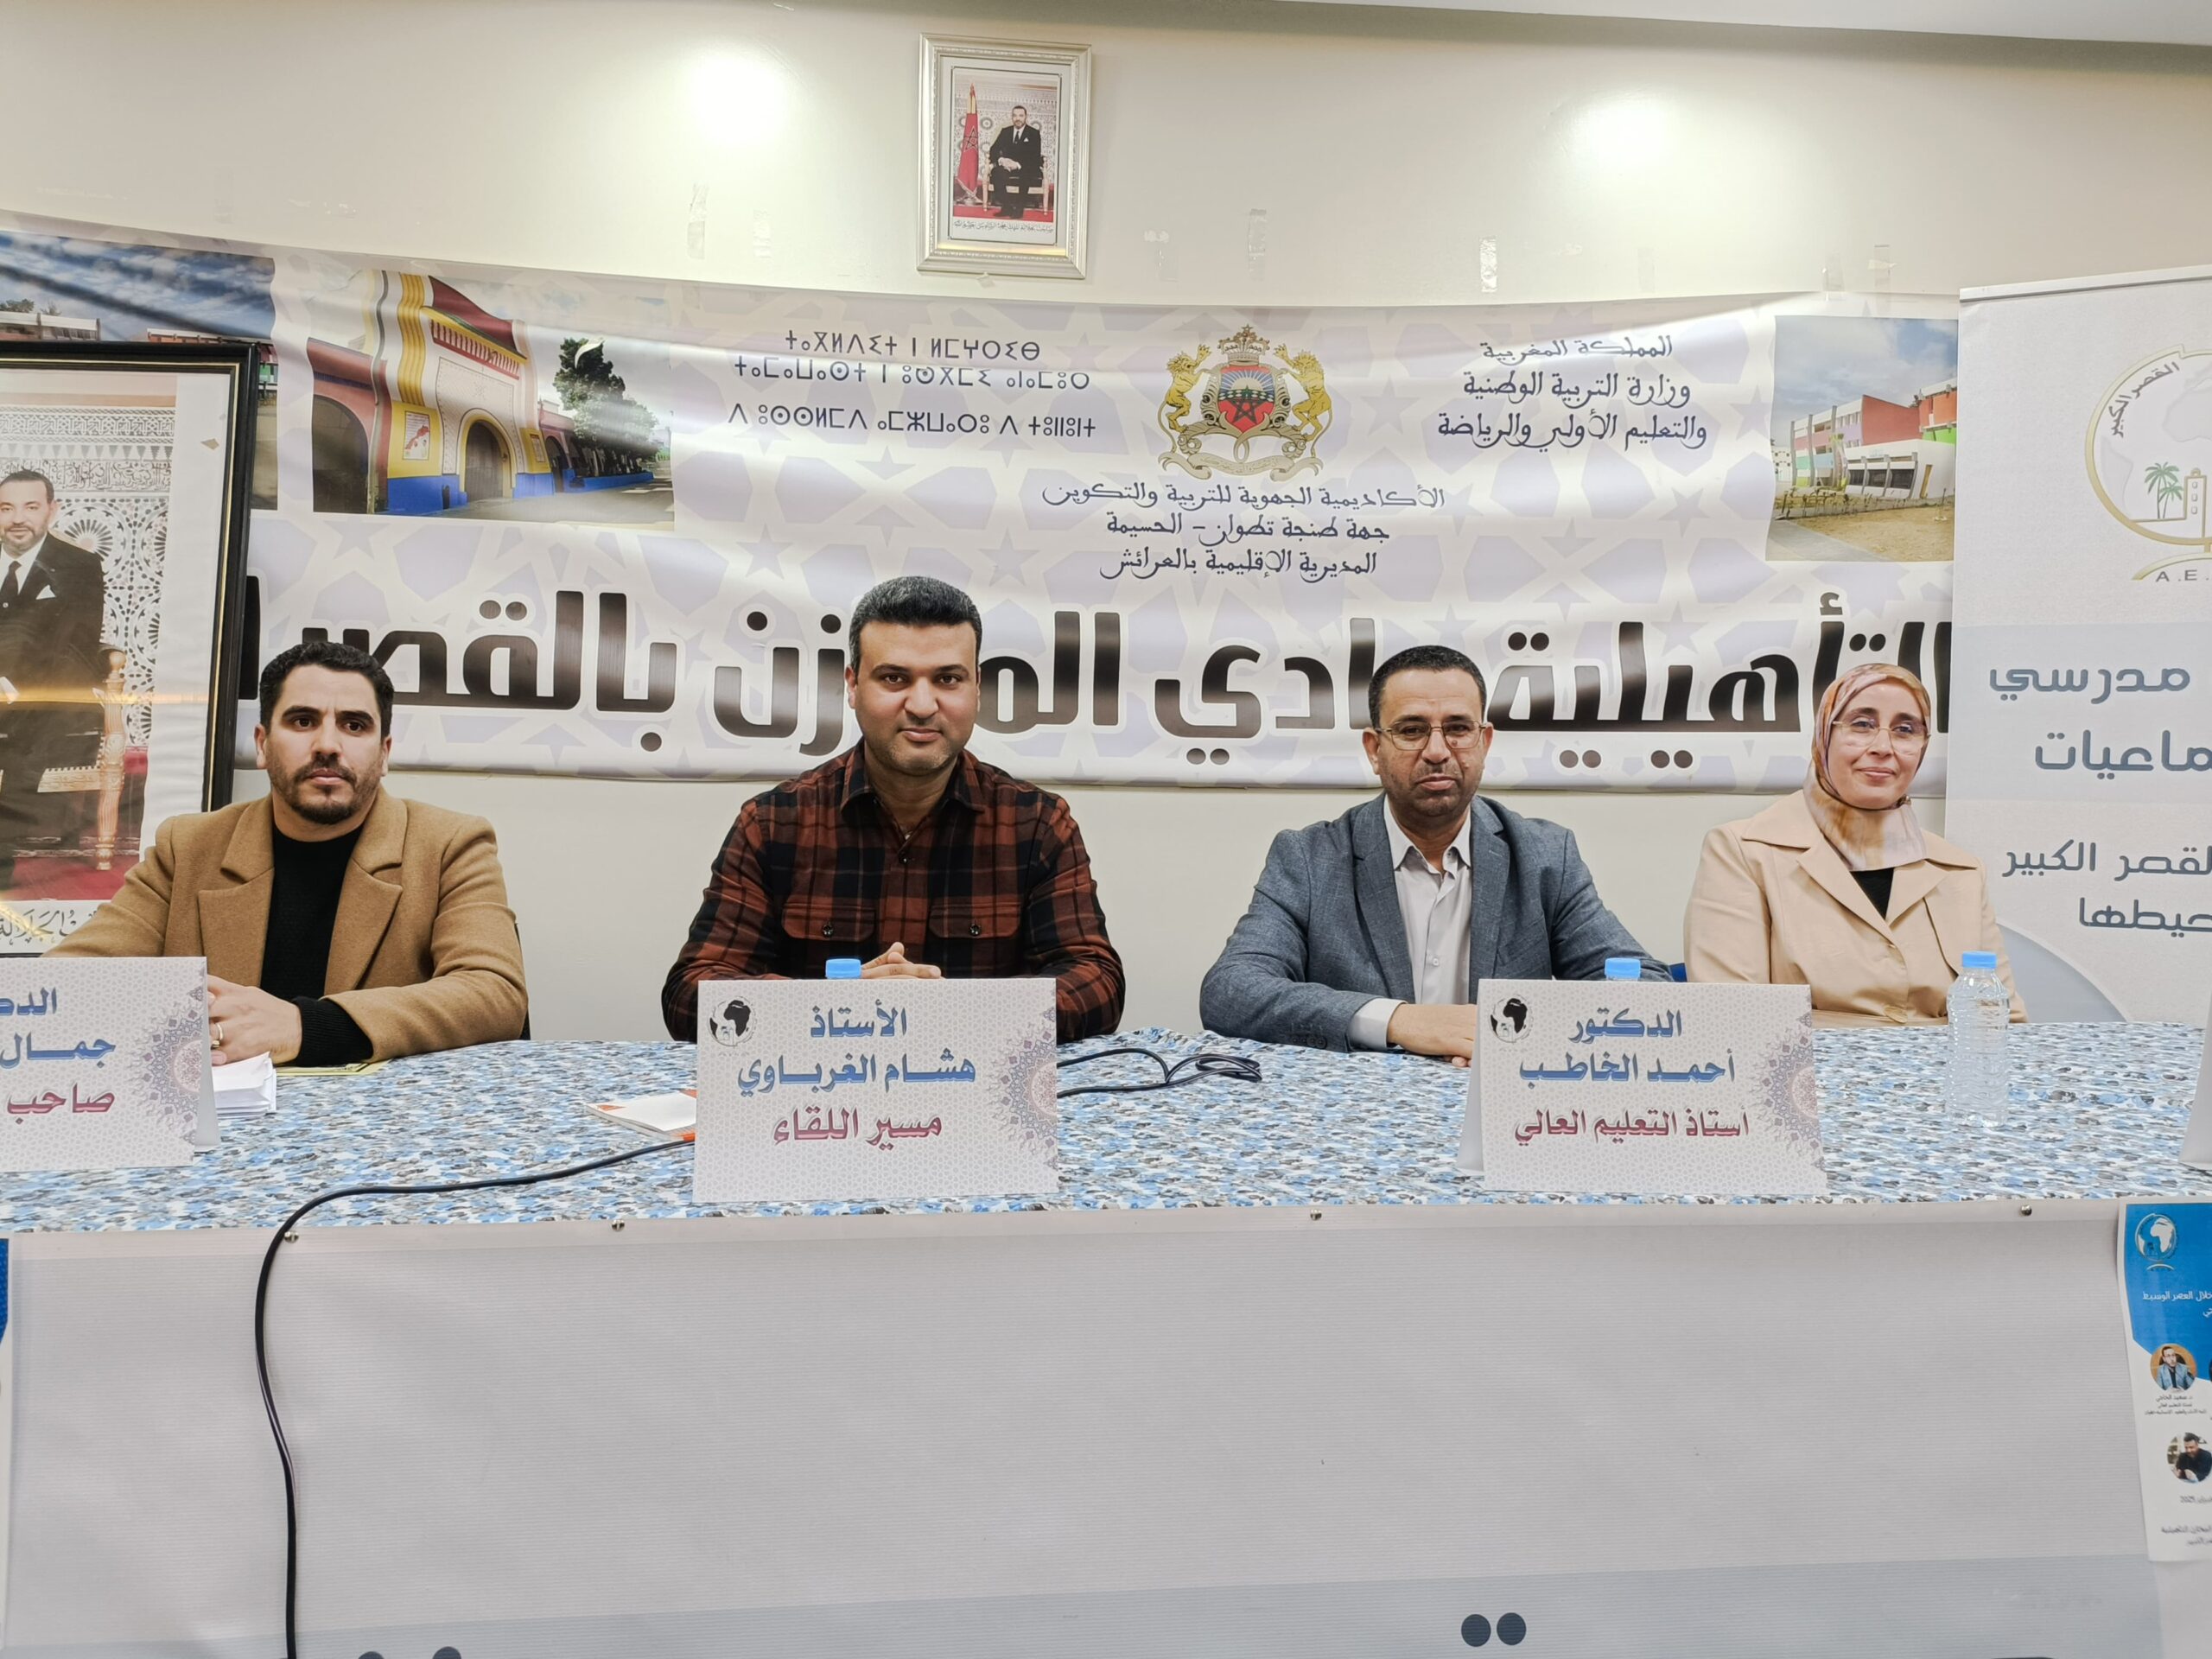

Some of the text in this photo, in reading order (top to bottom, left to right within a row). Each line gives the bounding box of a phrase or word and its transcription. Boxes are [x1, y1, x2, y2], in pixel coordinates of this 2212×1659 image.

[1480, 334, 1673, 366] المملكة المغربية
[1464, 371, 1691, 410] وزارة التربية الوطنية
[2108, 361, 2180, 439] القصر الكبير
[1438, 408, 1707, 453] والتعليم الأولي والرياضة
[1041, 482, 1446, 512] الأكاديمية الجهوية للتربية والتكوين
[1106, 512, 1182, 536] الحسيمة
[1282, 515, 1338, 543] طنجة
[1345, 518, 1389, 541] جهة
[1099, 547, 1377, 583] المديرية الإقليمية بالعرائش
[1989, 668, 2190, 704] مدرسي
[2002, 839, 2096, 878] الكبير
[810, 999, 907, 1038] الأستاذ
[1568, 1007, 1682, 1045] الدكتور
[737, 1048, 976, 1097] هشام الغرباوي
[1519, 1048, 1736, 1090] أحمد الخاطب
[7, 1083, 116, 1124] صاحب
[772, 1105, 943, 1151] مسير اللقاء
[1514, 1105, 1750, 1147] أستاذ التعليم العالي
